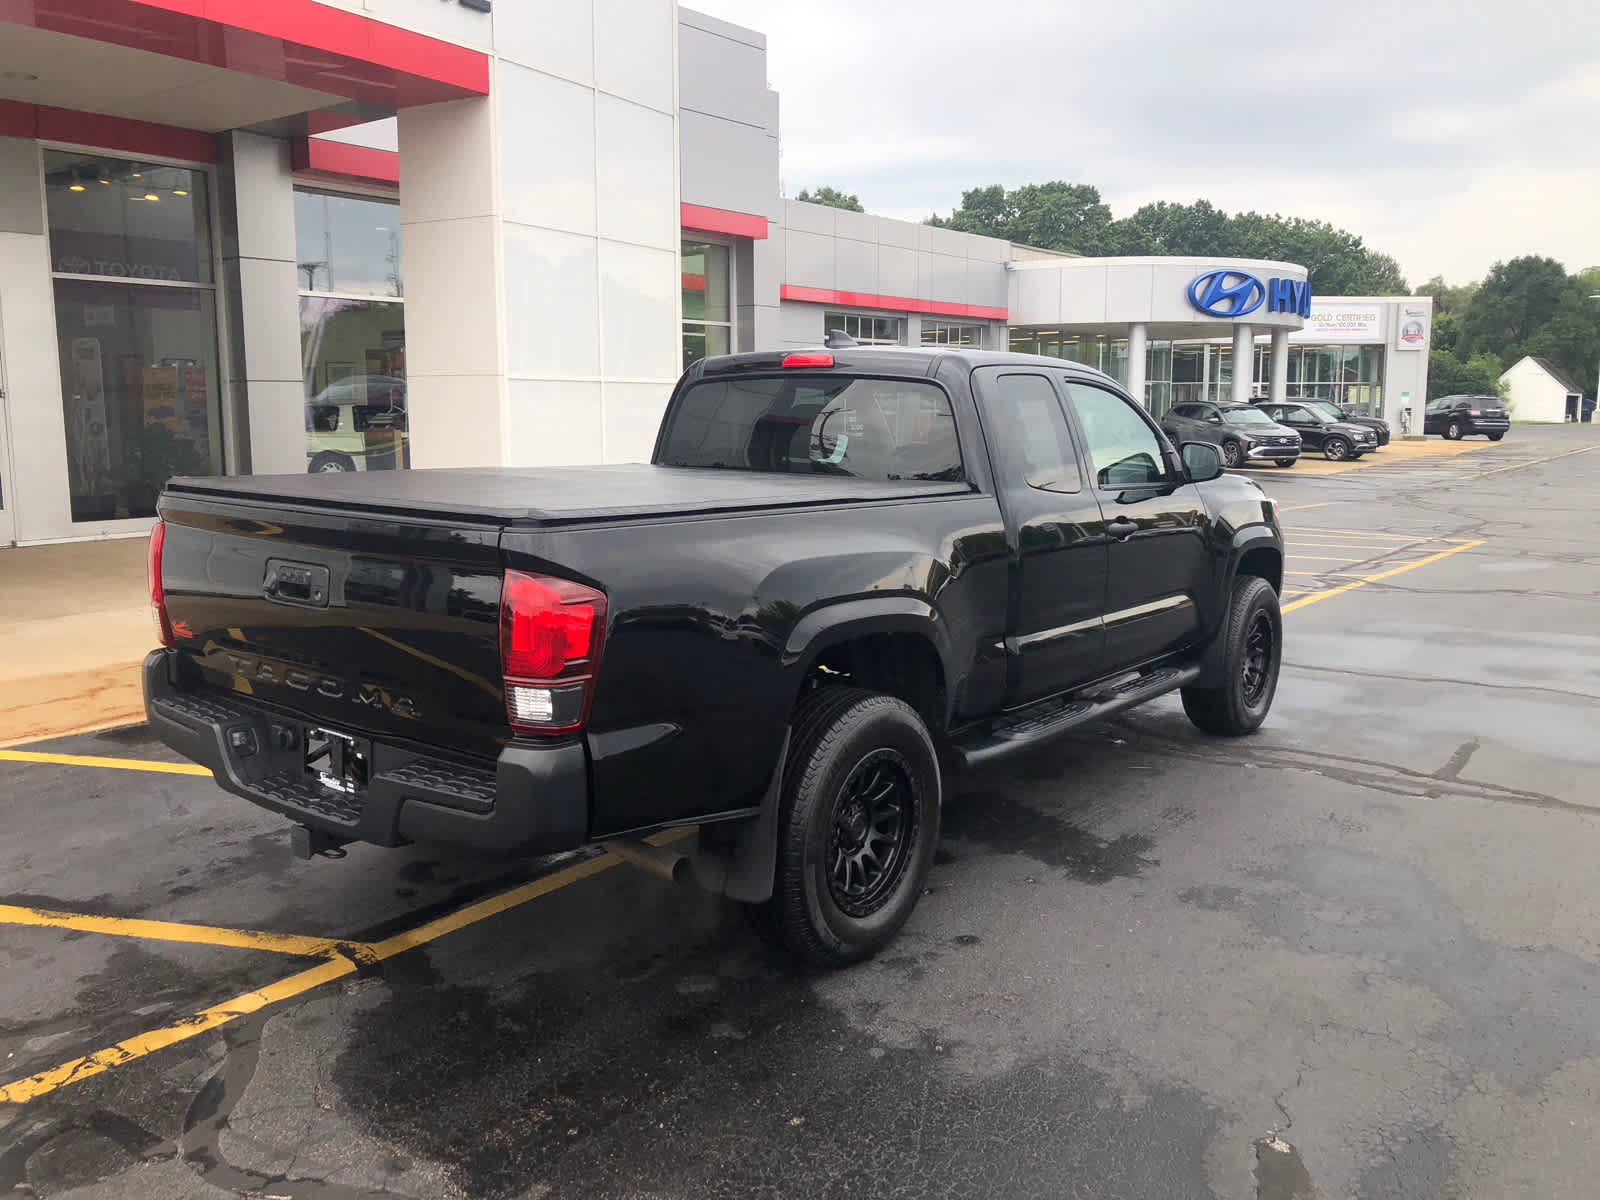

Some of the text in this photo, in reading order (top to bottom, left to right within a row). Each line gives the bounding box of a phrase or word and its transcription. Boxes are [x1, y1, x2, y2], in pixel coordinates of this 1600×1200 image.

[95, 260, 183, 281] TOYOTA
[1311, 313, 1376, 322] GOLD CERTIFIED
[228, 655, 423, 717] TACOMA
